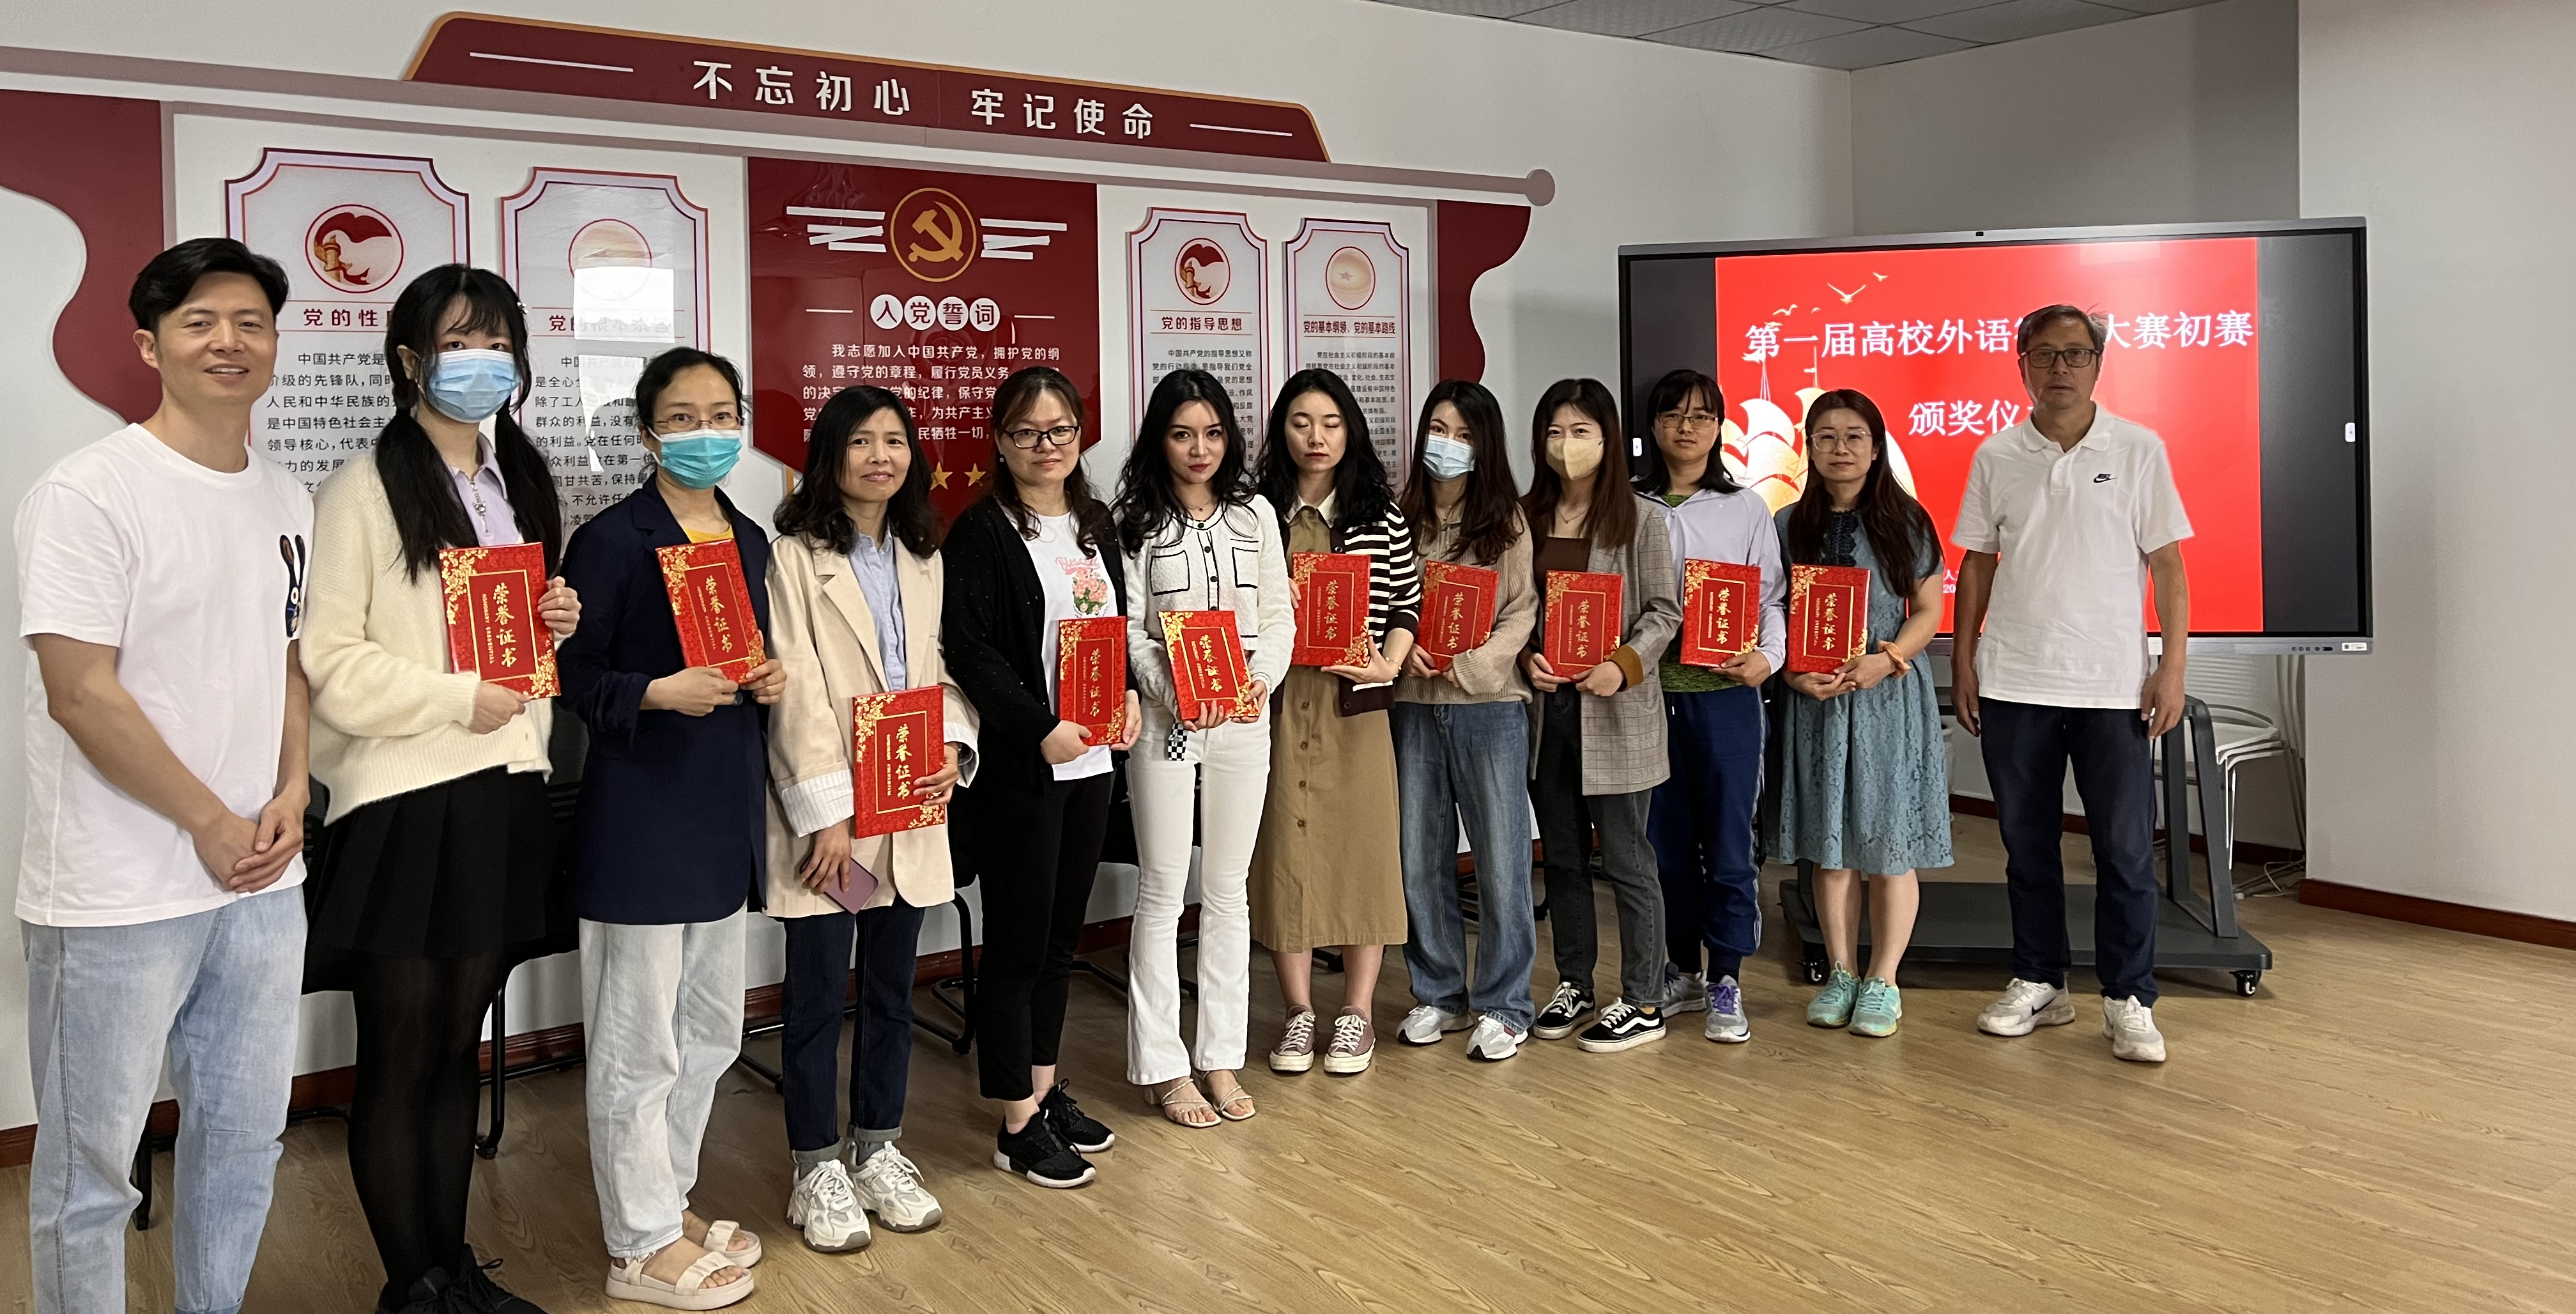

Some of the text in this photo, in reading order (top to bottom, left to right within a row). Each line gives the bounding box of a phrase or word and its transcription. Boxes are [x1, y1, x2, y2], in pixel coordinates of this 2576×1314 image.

[693, 61, 1153, 139] 不忘初心 牢记使命
[1162, 316, 1243, 331] 党的指导思想
[266, 395, 396, 409] 人民和中华民族的
[267, 417, 394, 430] 是中国特色社会主
[1908, 399, 2034, 438] 颁奖仪
[493, 582, 517, 668] 荣誉证书
[705, 575, 733, 653] 荣誉证书
[1447, 592, 1464, 650] 荣誉证书
[1575, 599, 1591, 658] 荣誉证书
[1715, 587, 1731, 645] 荣誉证书
[895, 723, 912, 800] 荣誉证书
